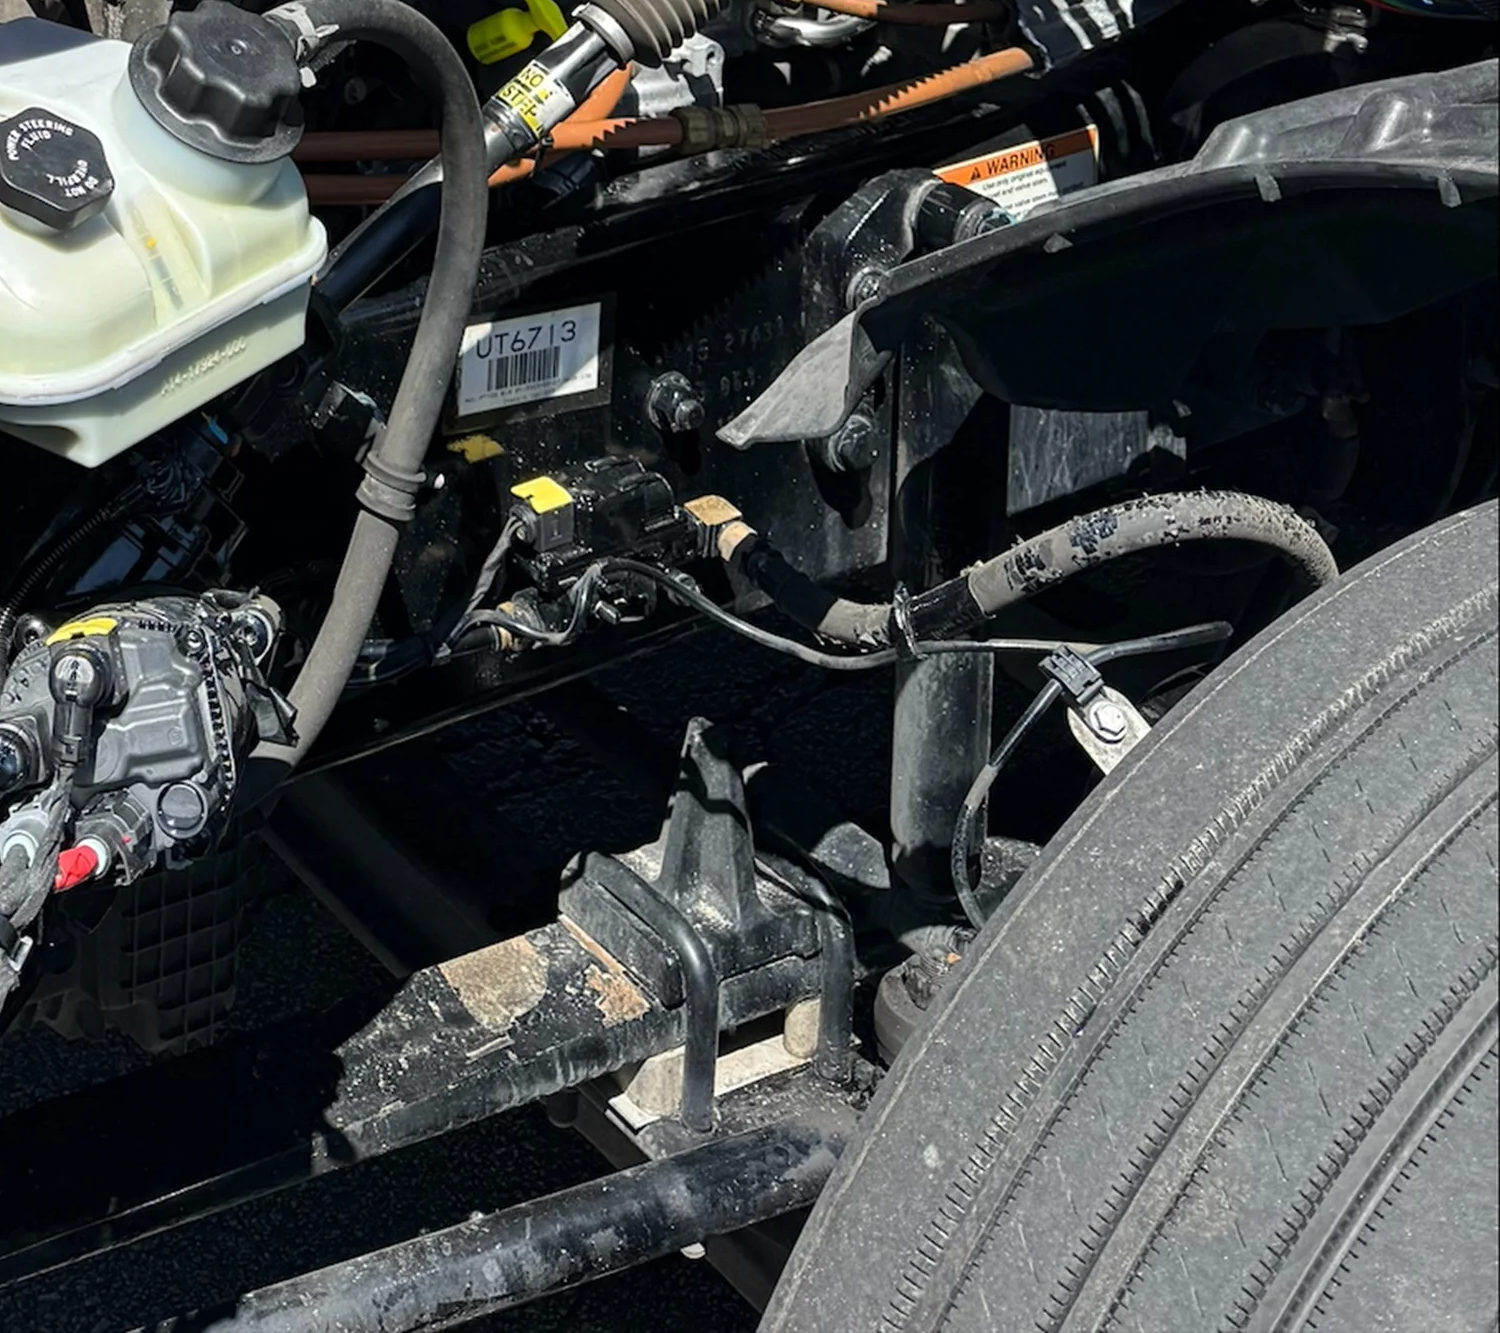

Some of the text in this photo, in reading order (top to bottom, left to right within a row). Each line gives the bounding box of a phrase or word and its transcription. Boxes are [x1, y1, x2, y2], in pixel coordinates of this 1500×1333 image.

[520, 67, 544, 88] NO
[6, 119, 74, 160] POWER STEERING
[21, 130, 52, 149] FLUID
[46, 159, 88, 186] OVERFILL
[986, 144, 1056, 175] WARNING
[477, 320, 577, 359] UT6713
